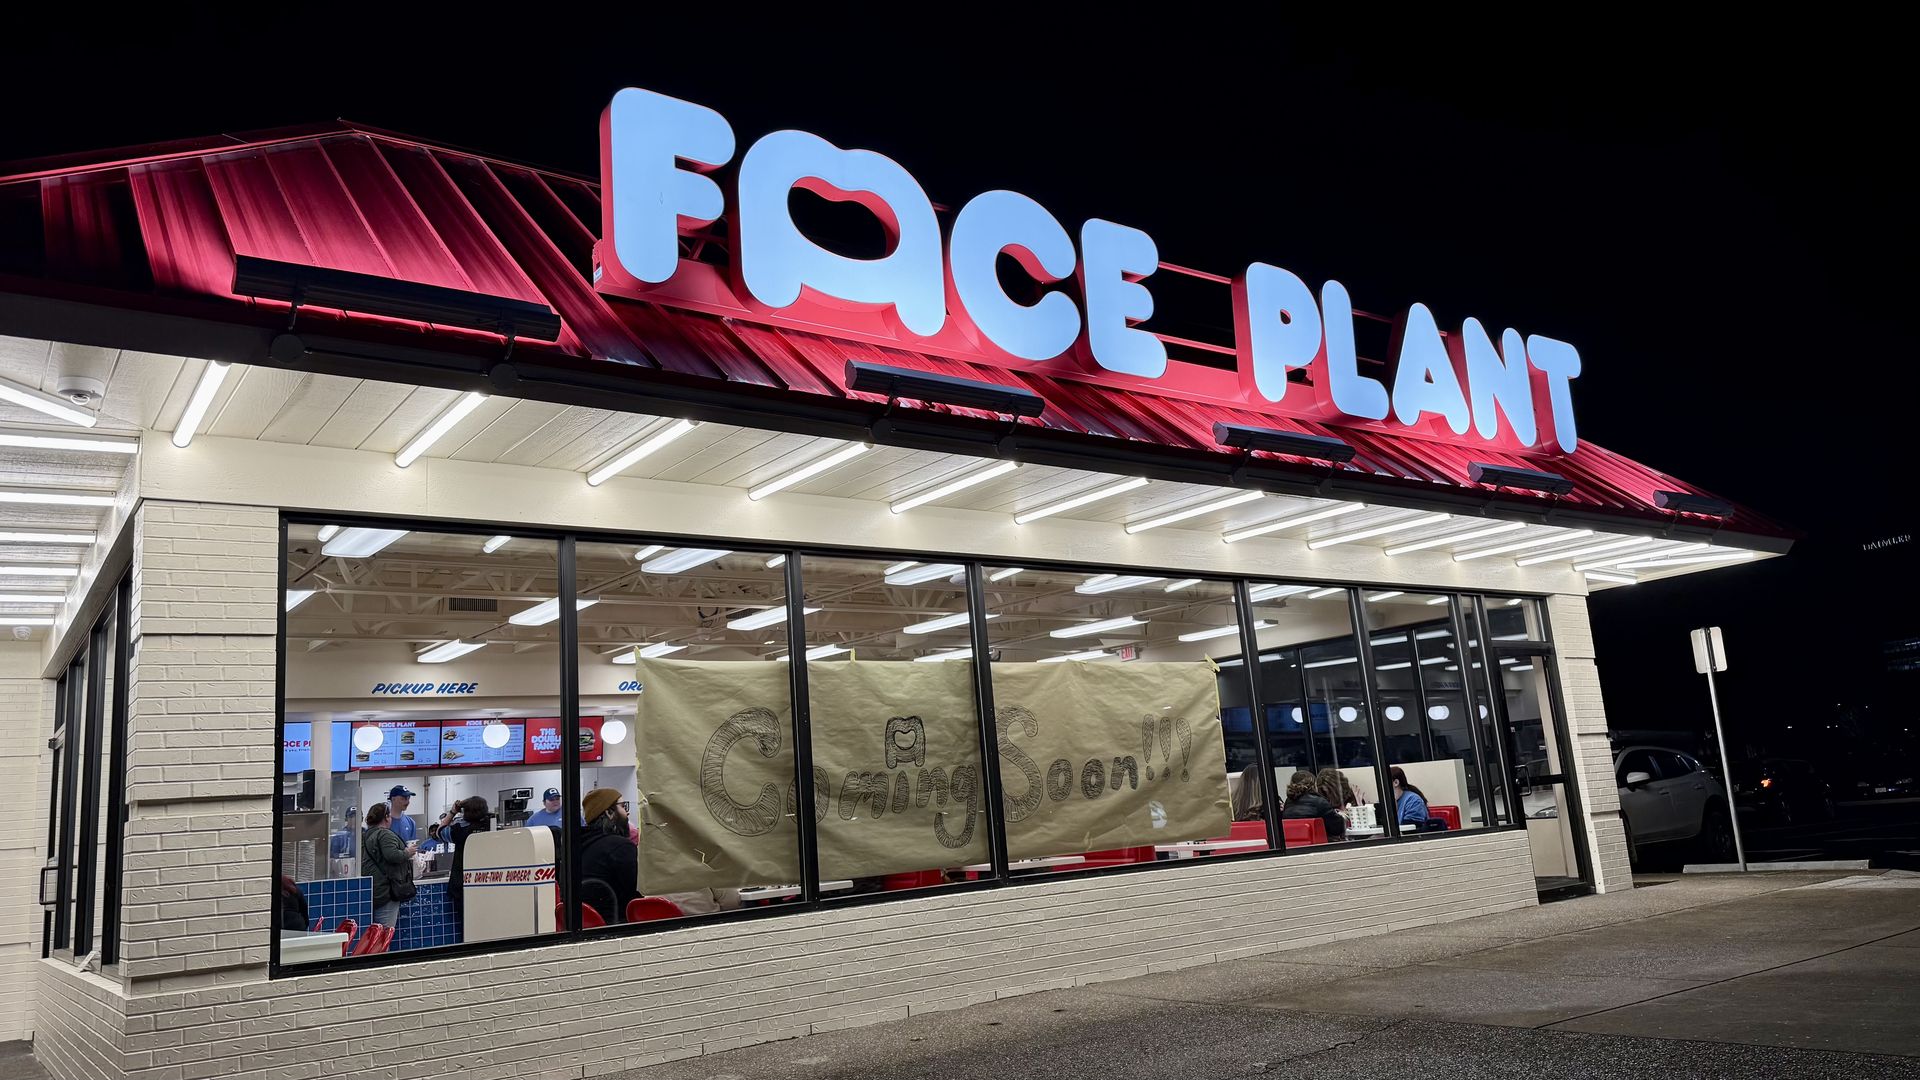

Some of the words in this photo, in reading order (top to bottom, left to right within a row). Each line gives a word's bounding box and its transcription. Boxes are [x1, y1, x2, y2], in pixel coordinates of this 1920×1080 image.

[610, 86, 1168, 379] FACE
[1246, 261, 1582, 455] PLANT
[371, 682, 435, 695] PICKUP
[436, 682, 479, 694] HERE
[539, 727, 556, 736] THE
[531, 735, 562, 744] DOUBL
[533, 742, 561, 751] FANCY
[996, 705, 1192, 823] Soon!!!
